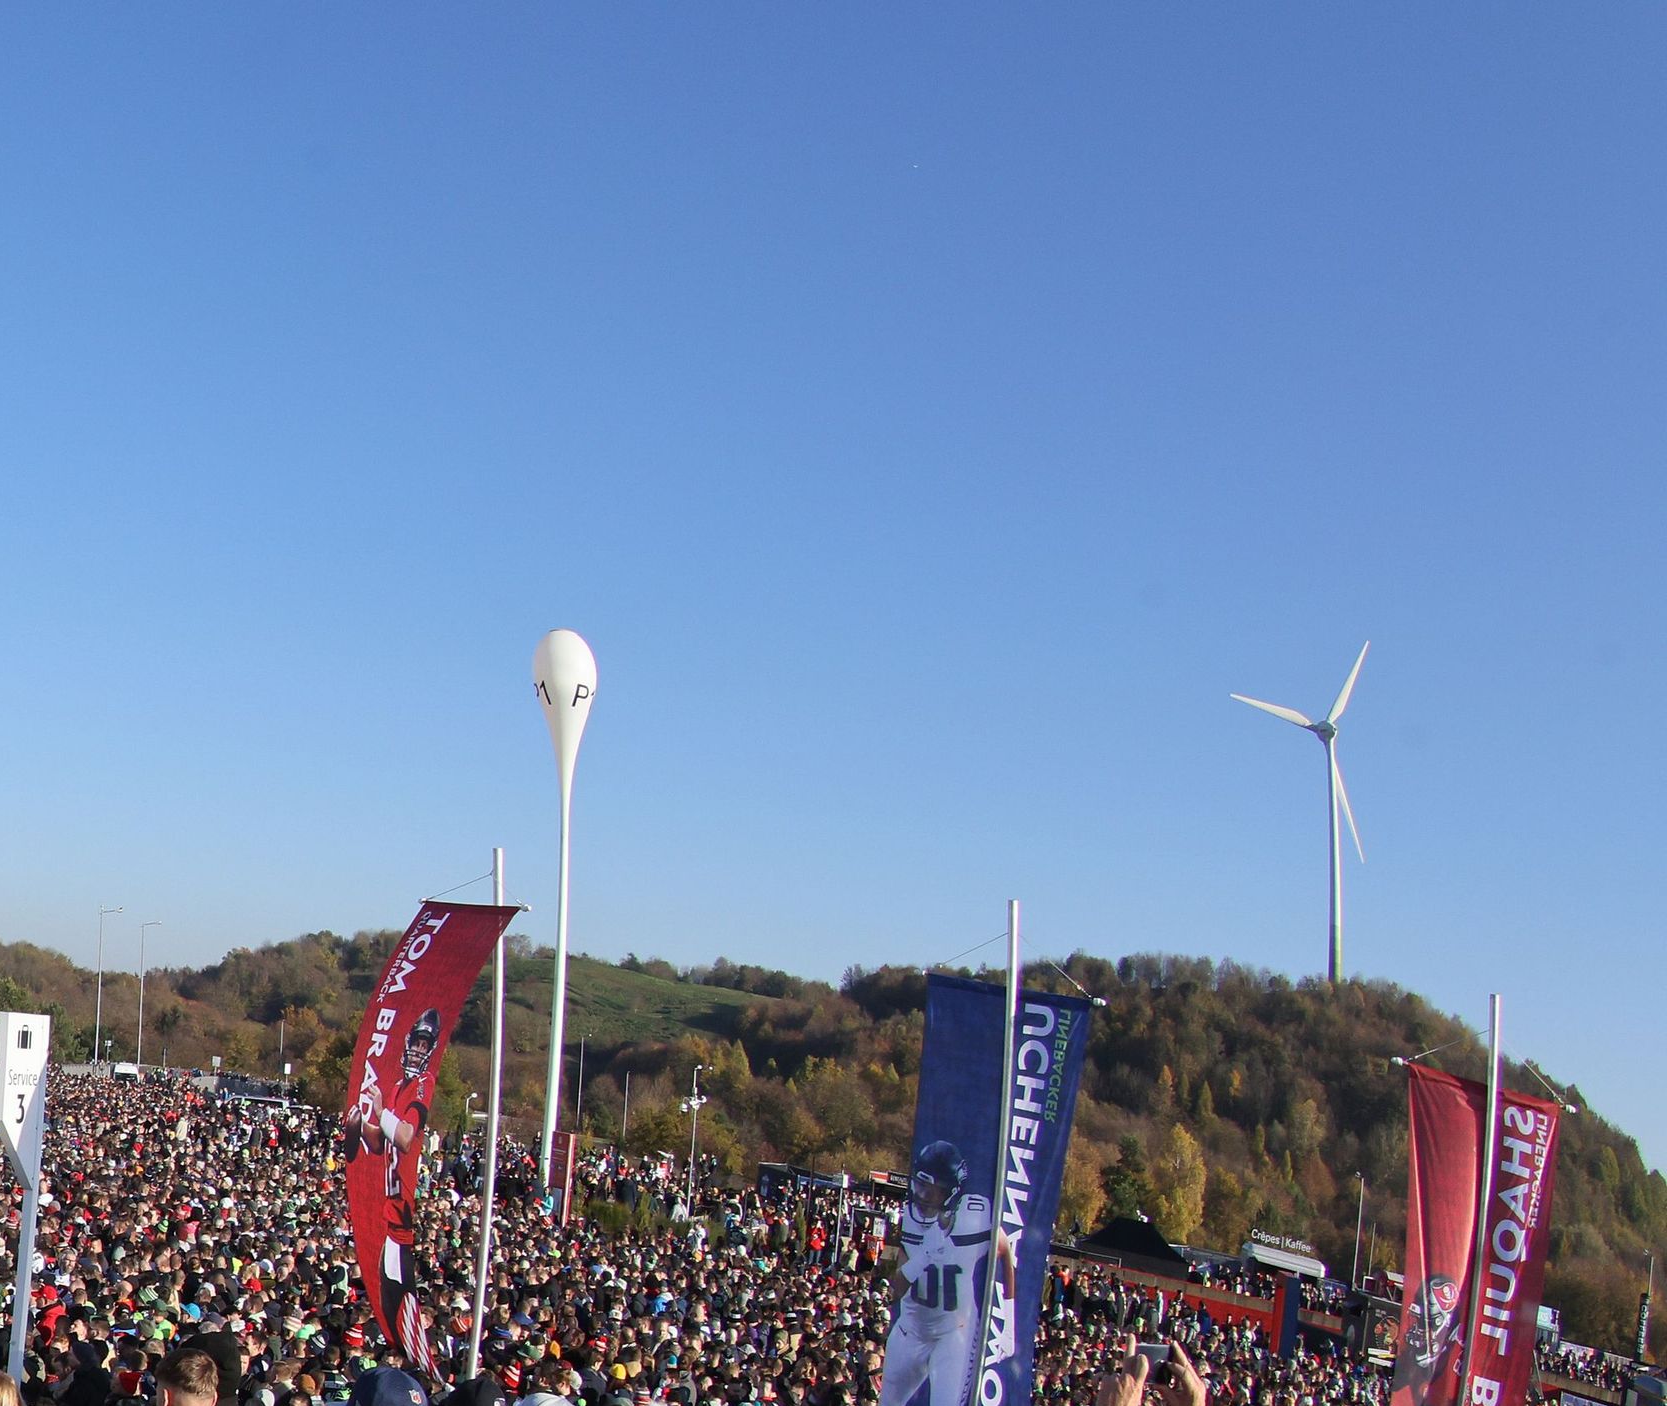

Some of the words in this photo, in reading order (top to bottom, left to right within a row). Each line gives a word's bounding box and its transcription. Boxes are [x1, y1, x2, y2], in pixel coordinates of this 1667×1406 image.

[376, 911, 431, 1003] QUARTERBACK
[388, 912, 451, 993] TOM
[8, 1069, 38, 1087] Service
[16, 1094, 26, 1124] 3
[1251, 1229, 1280, 1245] Crêpes
[1285, 1238, 1312, 1252] Kaffee
